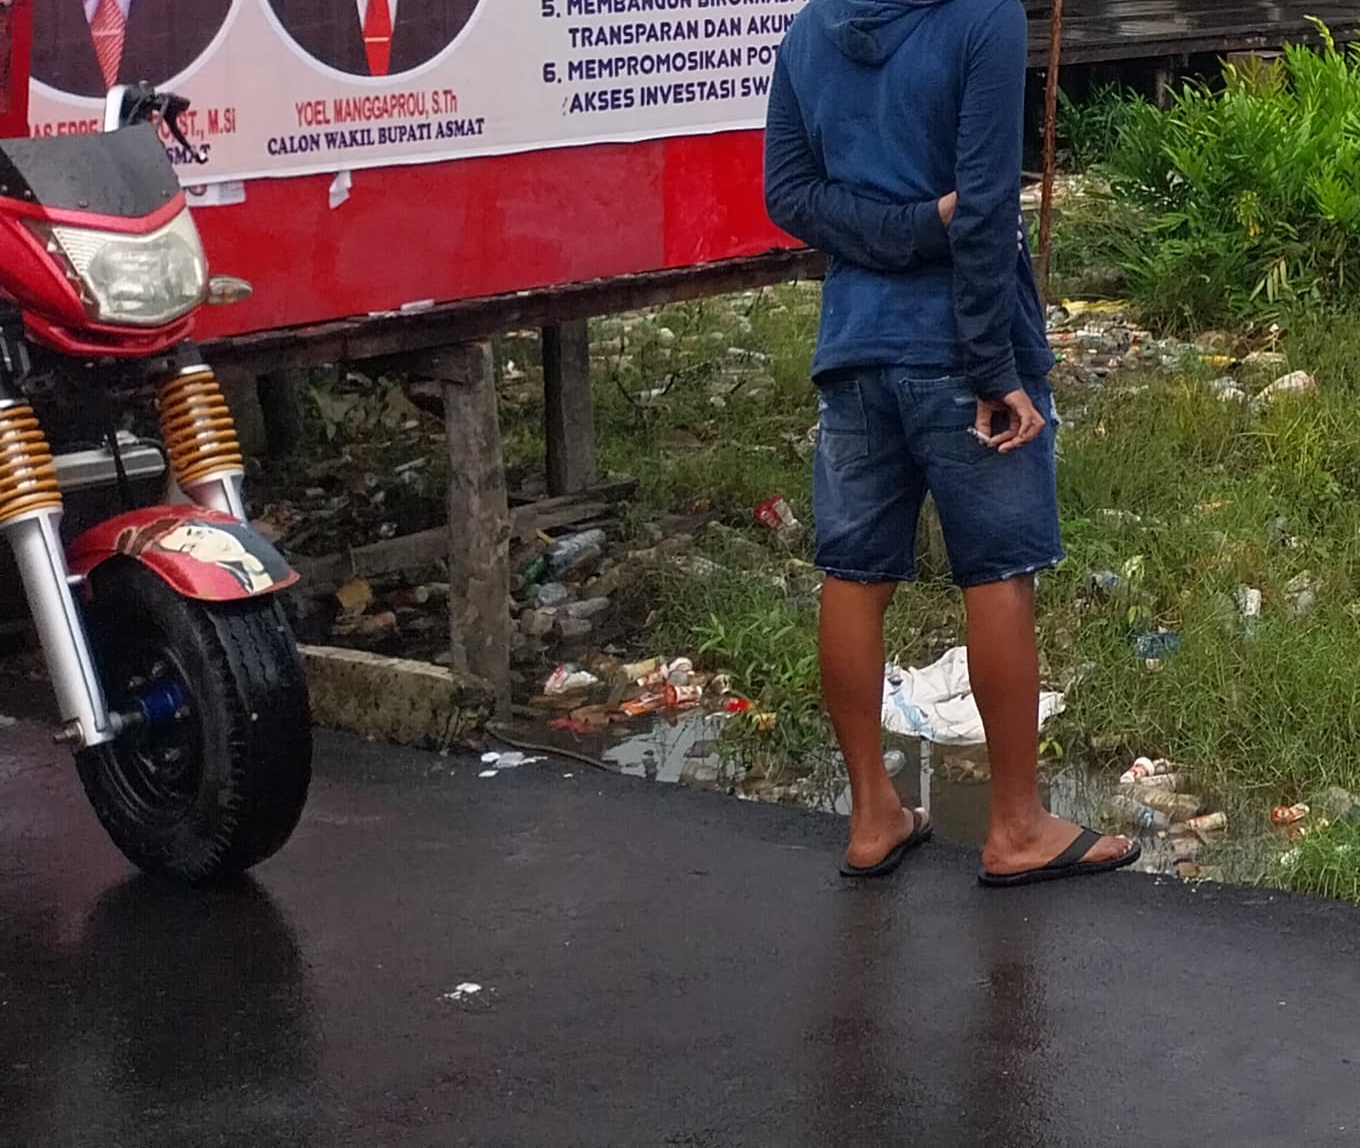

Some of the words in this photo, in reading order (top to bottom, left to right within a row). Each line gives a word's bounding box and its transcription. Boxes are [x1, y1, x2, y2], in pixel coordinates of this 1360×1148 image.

[568, 19, 699, 49] TRANSPARAN
[704, 17, 741, 38] DAN
[543, 62, 562, 85] 6.
[567, 47, 742, 82] MEMPROMOSIKAN
[295, 98, 331, 128] YOEL
[333, 90, 429, 124] MANGGAPROU,
[431, 88, 458, 116] S.Th
[569, 88, 634, 114] AKSES
[640, 79, 735, 107] INVESTASI
[268, 133, 322, 156] CALON
[323, 128, 376, 152] WAKIL
[377, 123, 432, 147] BUPATI
[434, 117, 486, 141] ASMAT
